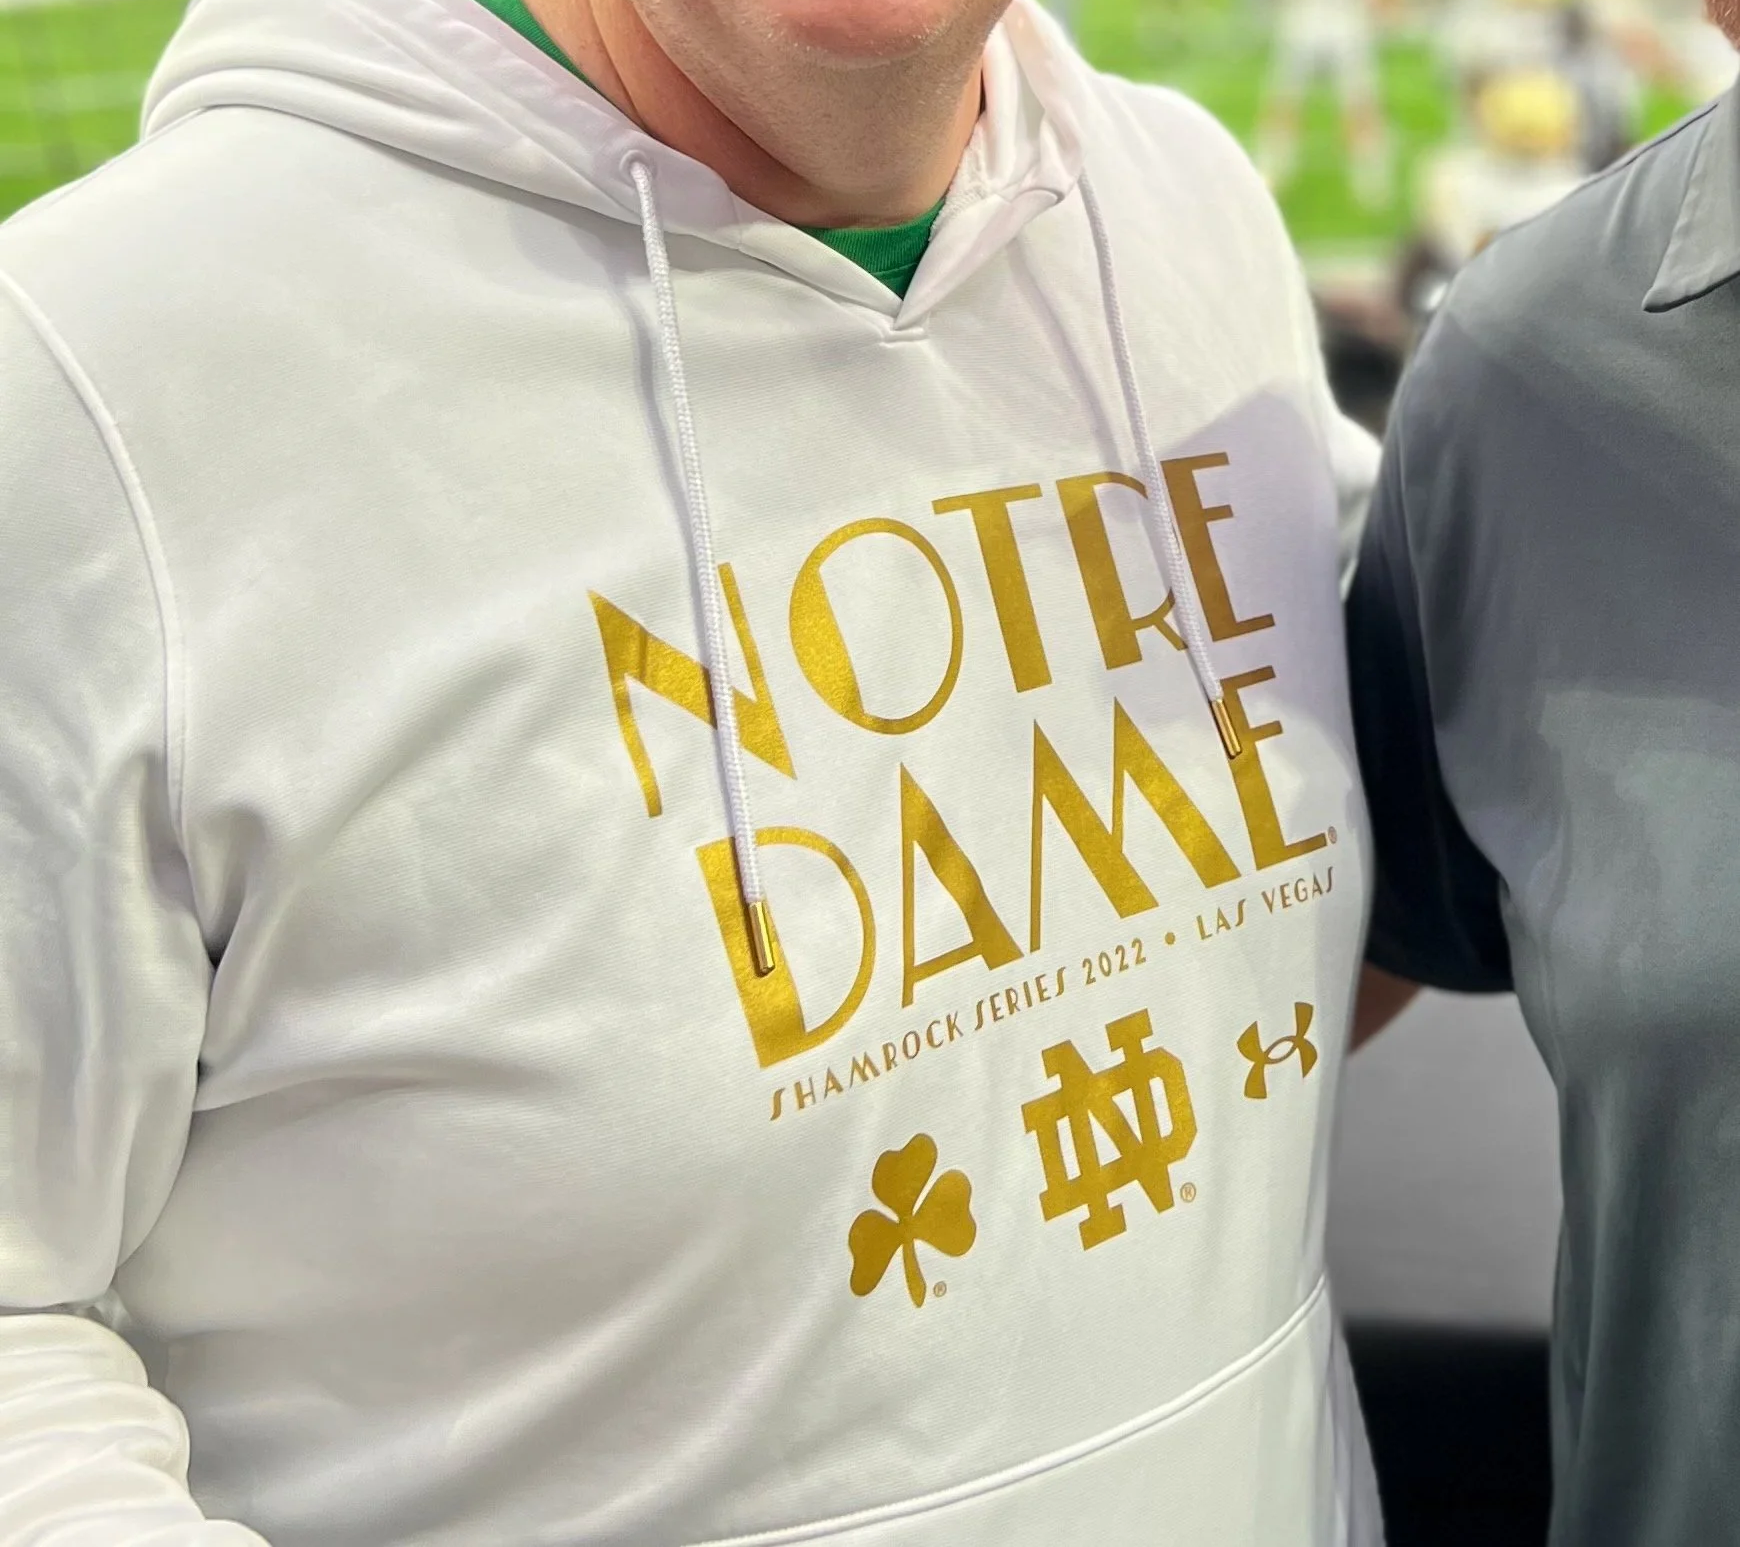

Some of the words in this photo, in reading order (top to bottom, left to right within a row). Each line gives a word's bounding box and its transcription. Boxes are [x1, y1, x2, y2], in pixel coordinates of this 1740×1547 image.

[585, 453, 1275, 820] NOTRE
[694, 666, 1327, 1071] DAME
[769, 1009, 963, 1123] SHAMROCK
[974, 966, 1067, 1032] SERIES
[1081, 938, 1147, 987] 2022
[1195, 898, 1247, 941] LAS
[1261, 865, 1335, 915] VEGAS
